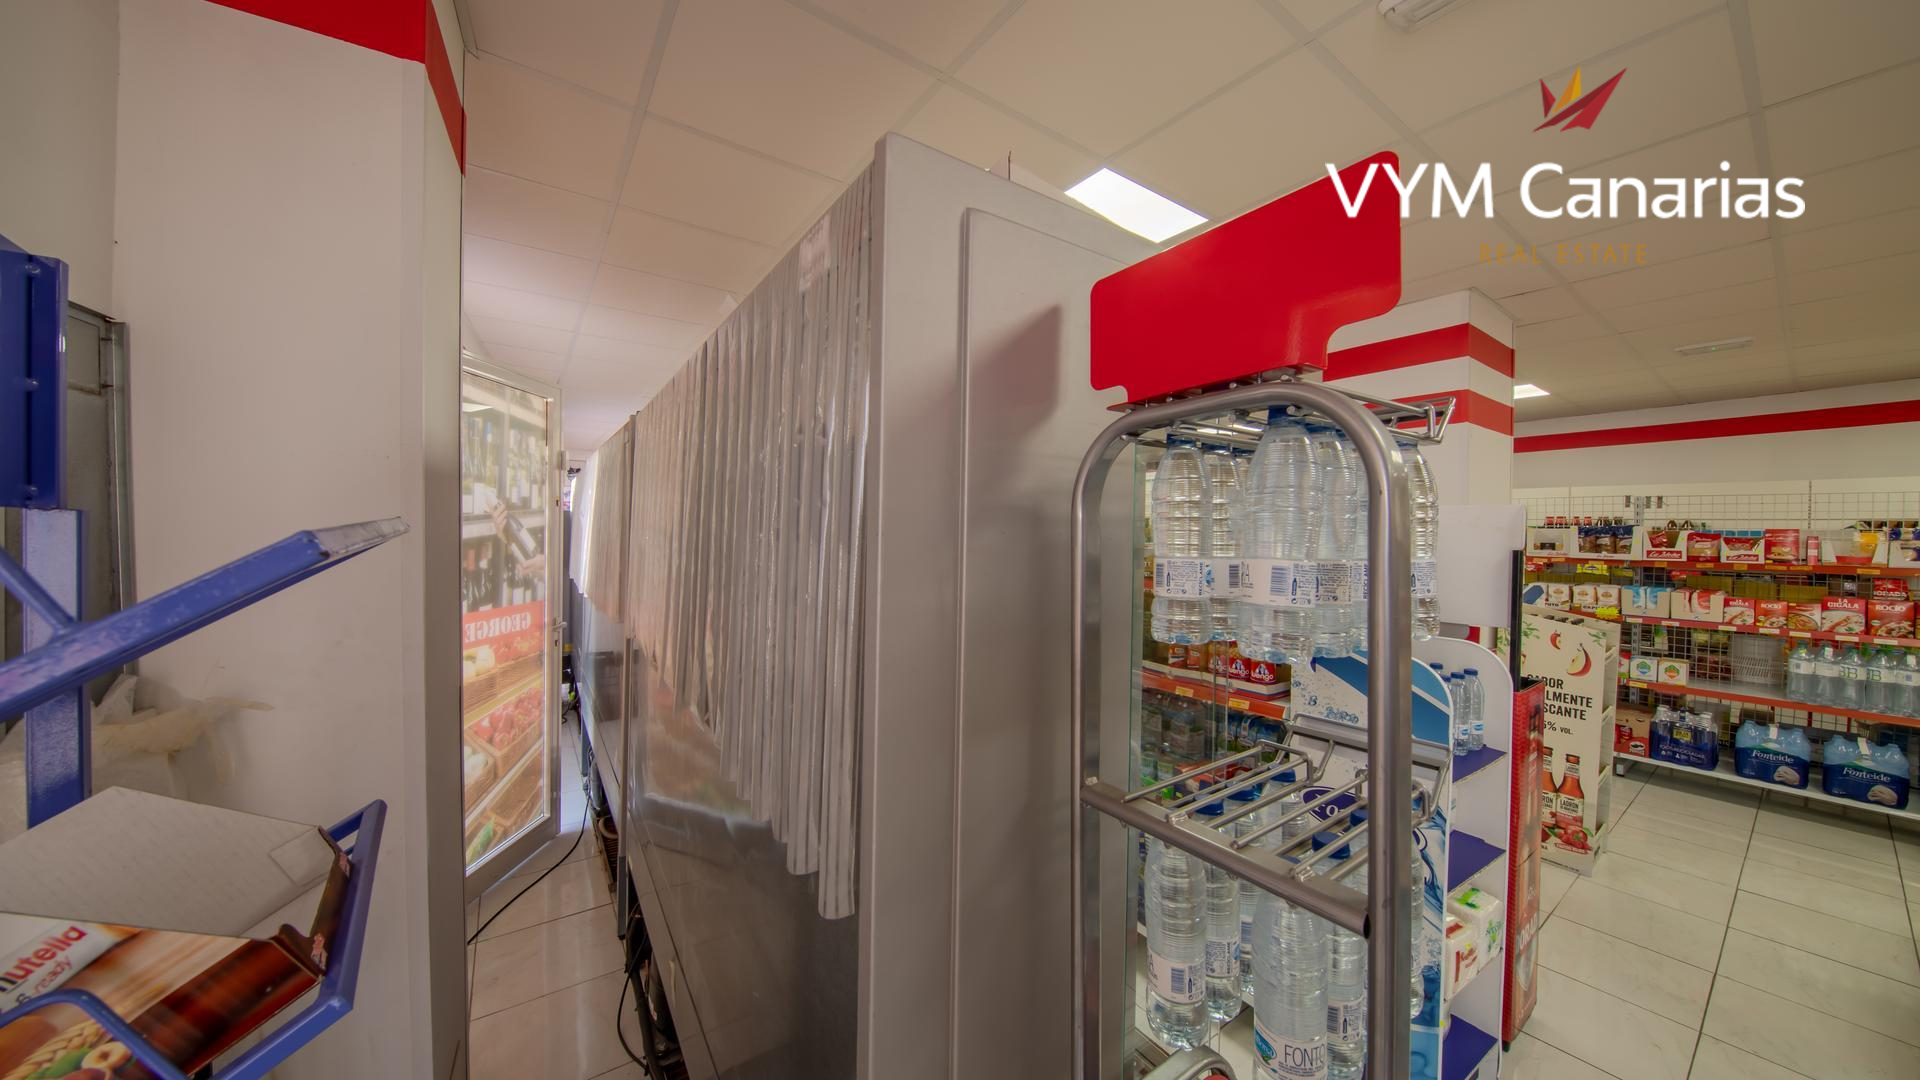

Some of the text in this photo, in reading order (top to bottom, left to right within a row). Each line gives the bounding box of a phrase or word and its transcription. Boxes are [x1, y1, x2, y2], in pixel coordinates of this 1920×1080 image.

[1827, 601, 1860, 609] CIGALA
[1527, 674, 1564, 690] BOR
[1546, 690, 1593, 709] LMENTE
[1543, 703, 1587, 721] SCANTE
[1752, 749, 1794, 764] Fonteide
[1842, 767, 1891, 783] Fonteide
